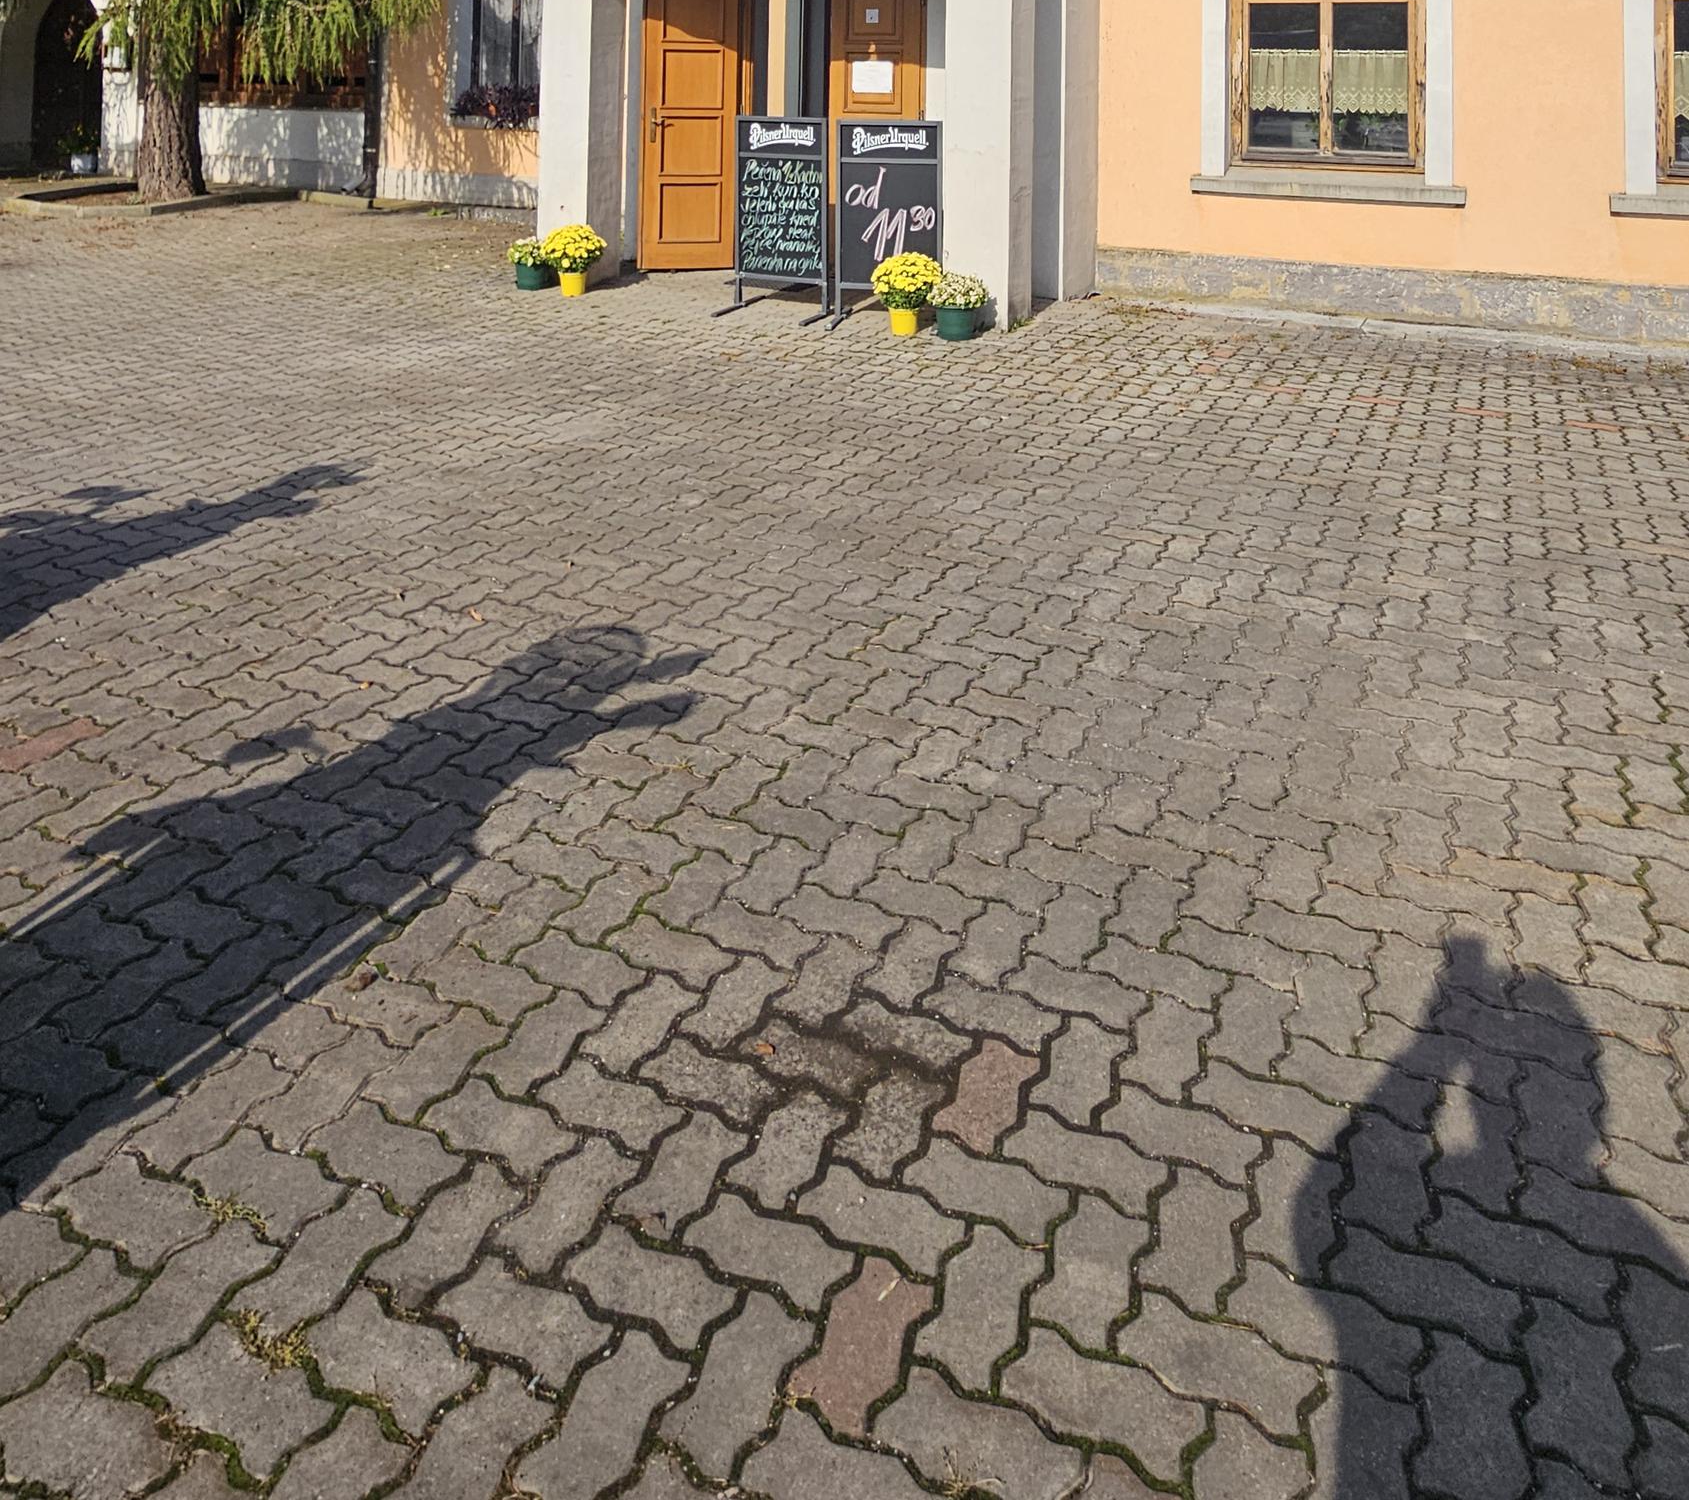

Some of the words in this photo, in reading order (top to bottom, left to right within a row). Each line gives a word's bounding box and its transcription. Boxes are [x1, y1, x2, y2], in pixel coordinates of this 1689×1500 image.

[749, 123, 783, 150] Pilsner
[852, 127, 890, 155] Pilsner
[845, 166, 887, 210] od
